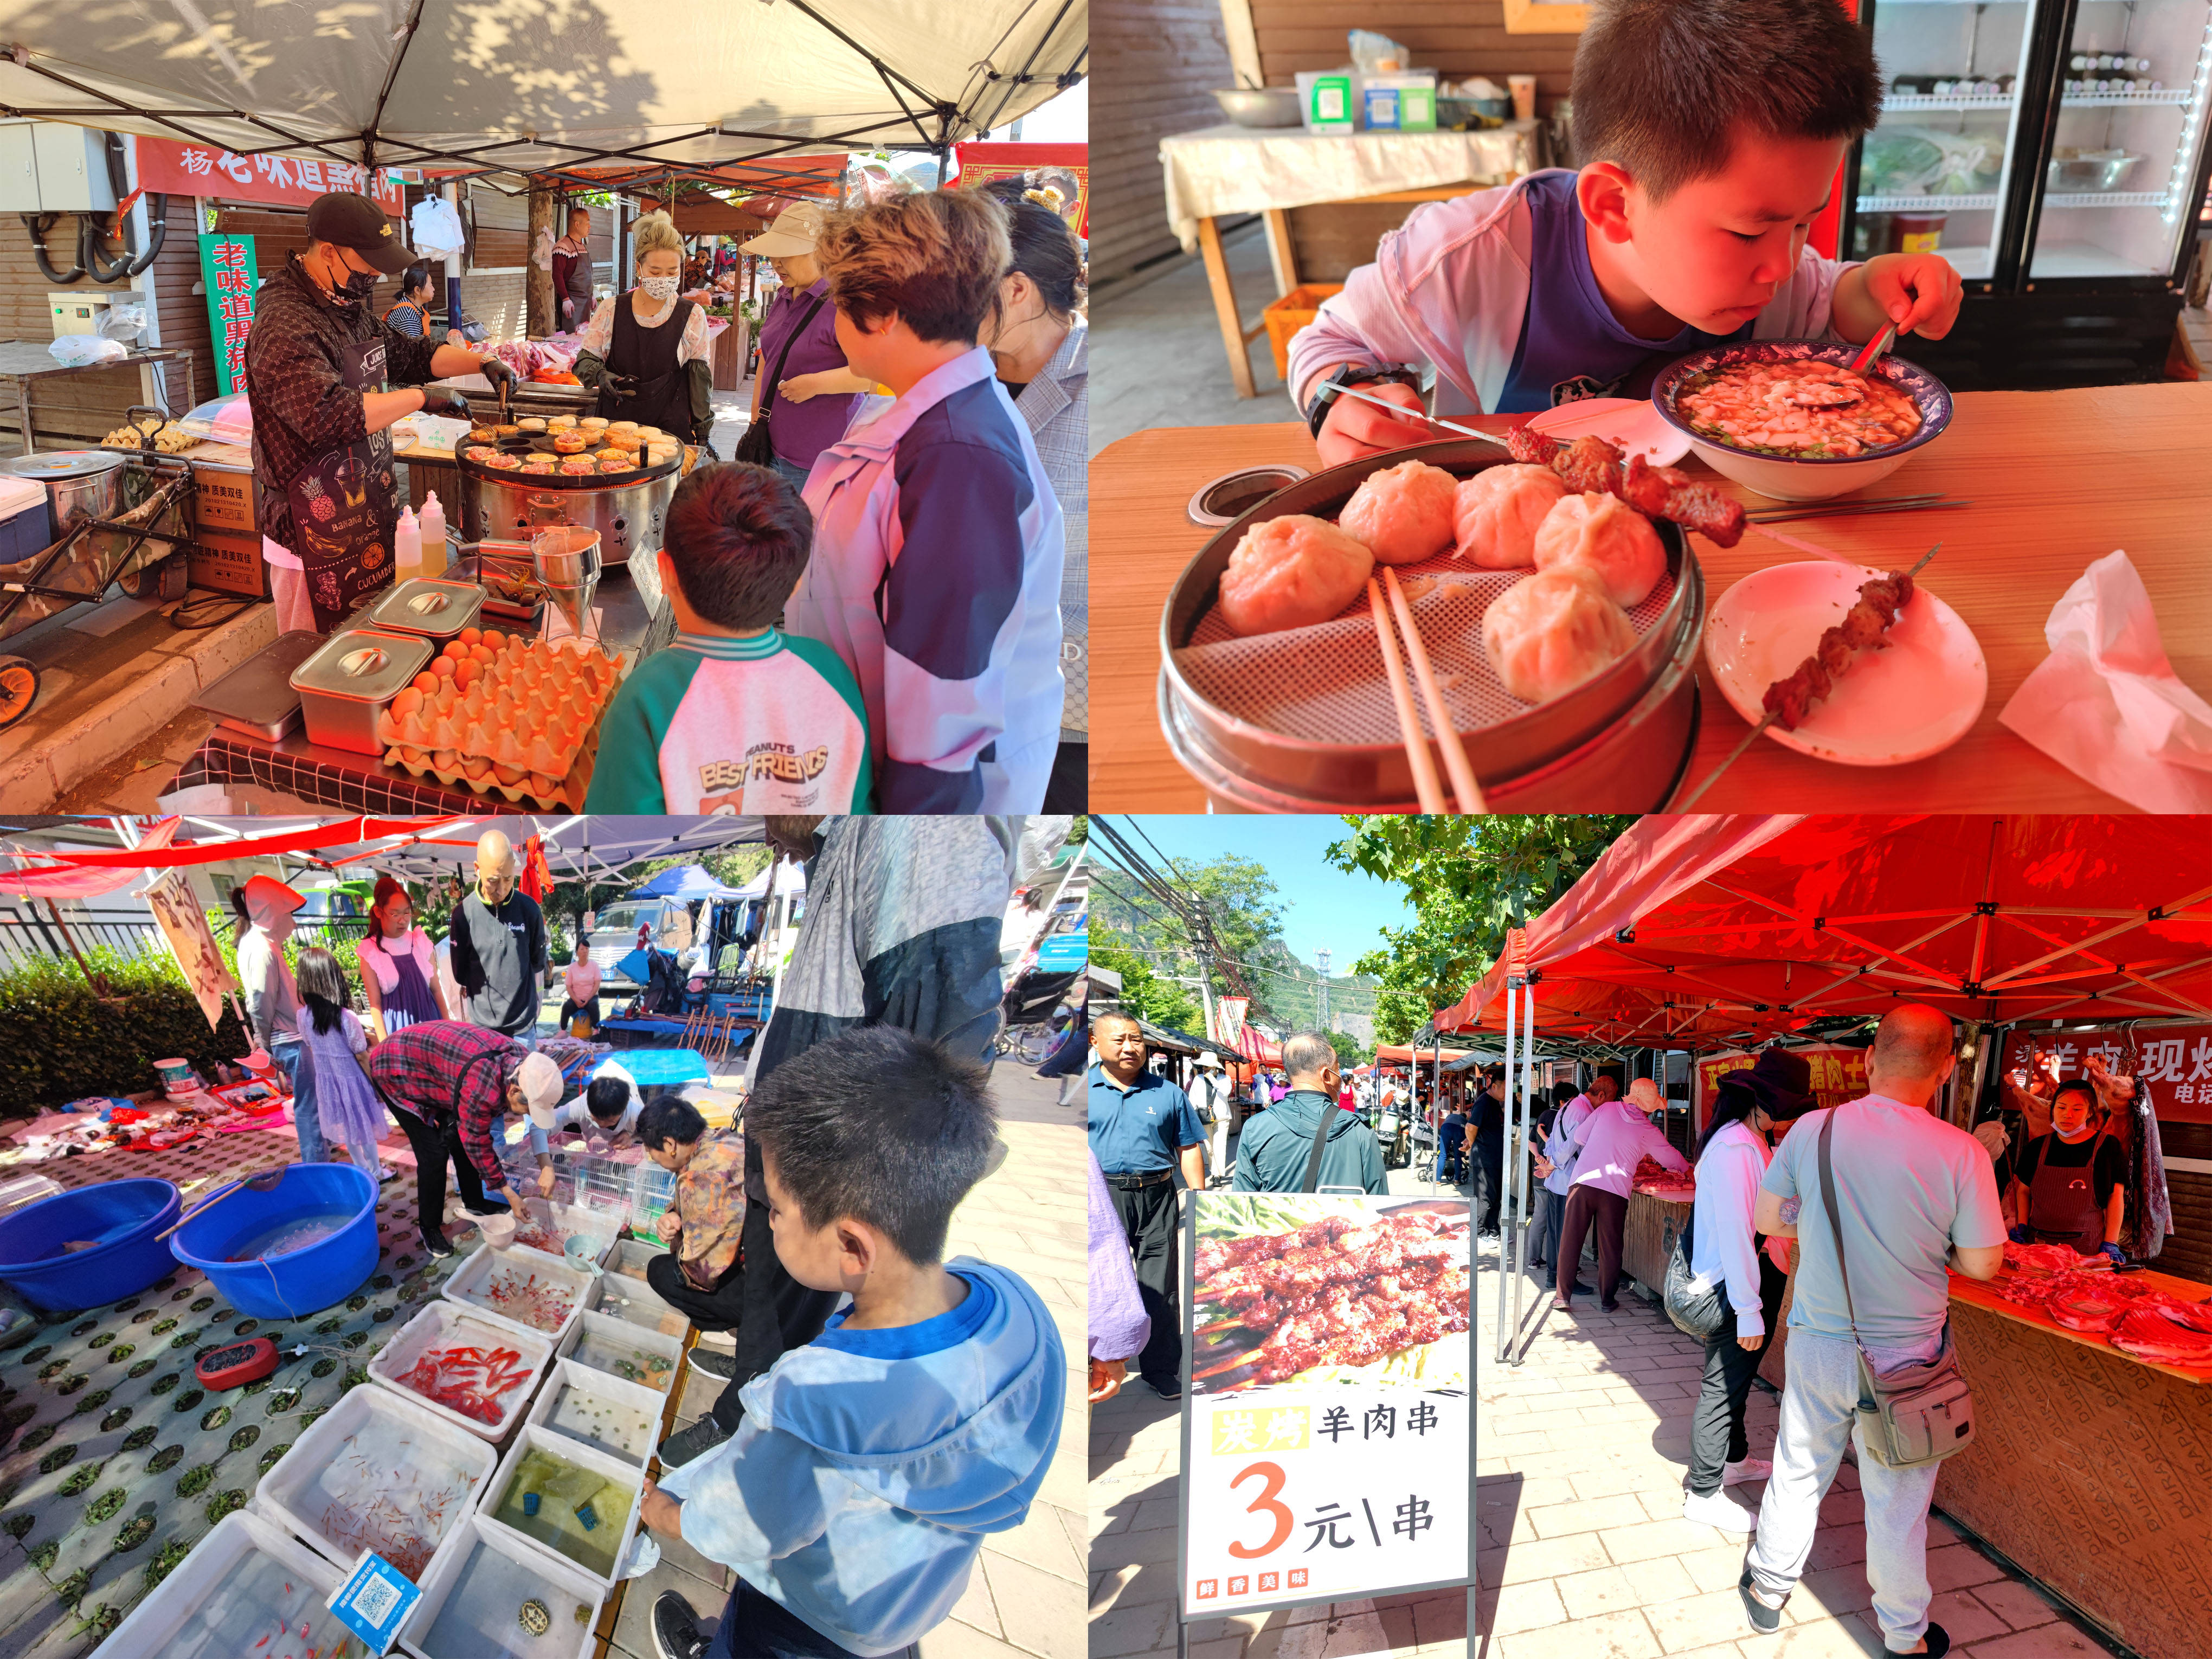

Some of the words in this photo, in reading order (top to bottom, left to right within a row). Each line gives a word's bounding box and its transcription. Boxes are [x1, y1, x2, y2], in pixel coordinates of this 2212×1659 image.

[370, 350, 382, 364] JUICE
[368, 429, 385, 458] LOS
[212, 485, 243, 499] 质美双佳
[221, 550, 252, 564] 质美双佳
[357, 562, 395, 590] CUCUMBER
[698, 759, 750, 794] BEST
[752, 745, 828, 784] FRIENDS
[745, 742, 795, 760] PEANUTS
[2009, 1353, 2065, 1439] DURAPLEX
[2033, 1338, 2091, 1425] DURAPLEX
[1215, 1407, 1307, 1453] 炭烤
[1317, 1400, 1438, 1443] 羊肉串
[1989, 1369, 2041, 1453] DURAPLEX
[2093, 1430, 2162, 1534] DURAPLEX
[2122, 1414, 2195, 1521] DURAPLEX
[2041, 1460, 2102, 1558] DURAPLEX
[2066, 1445, 2130, 1546] DURAPLEX
[339, 1560, 377, 1609] 推荐使用支付宝
